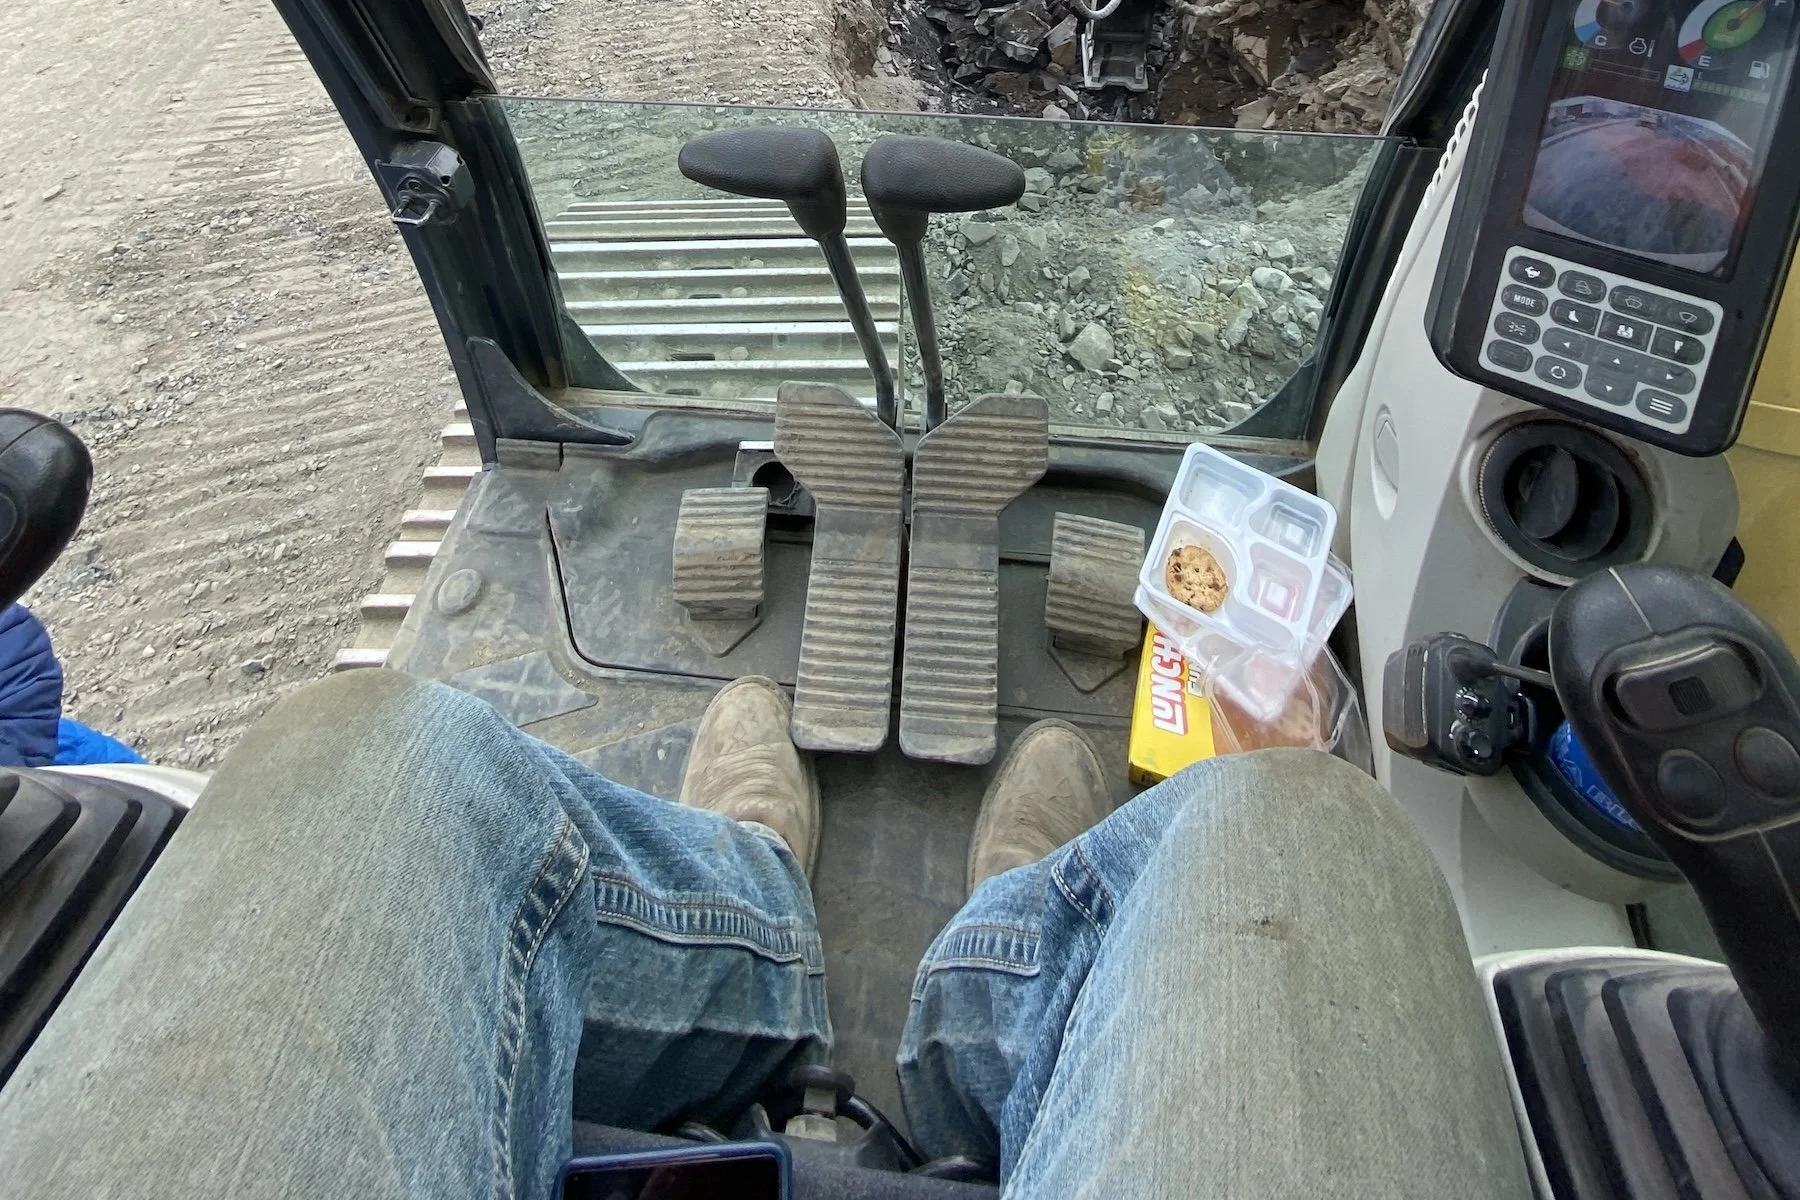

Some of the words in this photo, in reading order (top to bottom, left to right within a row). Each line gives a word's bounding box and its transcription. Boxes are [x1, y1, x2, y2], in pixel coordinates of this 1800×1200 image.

[1594, 35, 1607, 47] C
[1699, 54, 1712, 67] E
[1513, 293, 1537, 308] MODE
[1151, 626, 1189, 736] LUNCH
